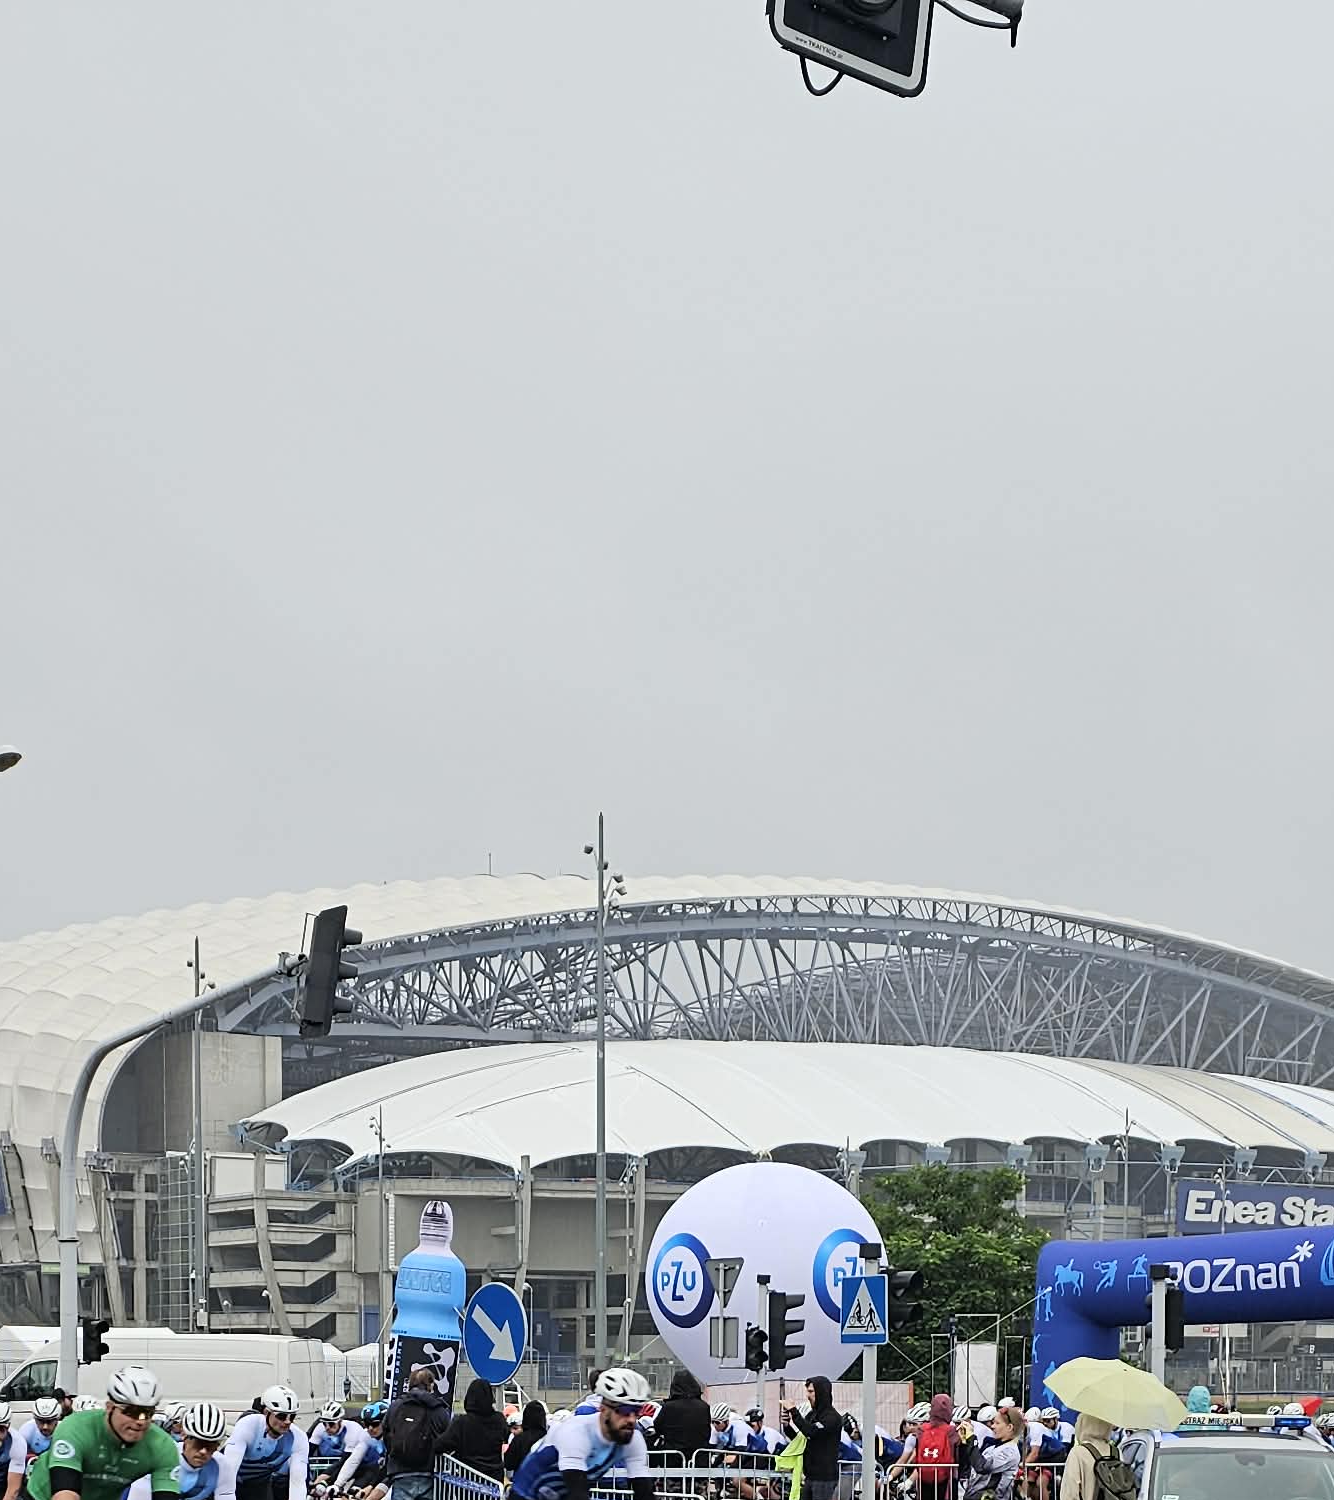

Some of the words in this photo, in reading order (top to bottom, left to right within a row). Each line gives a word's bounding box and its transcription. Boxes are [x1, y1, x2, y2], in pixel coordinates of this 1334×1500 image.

[1184, 1189, 1276, 1225] Enea
[661, 1260, 696, 1301] PZU
[832, 1256, 867, 1287] PZ
